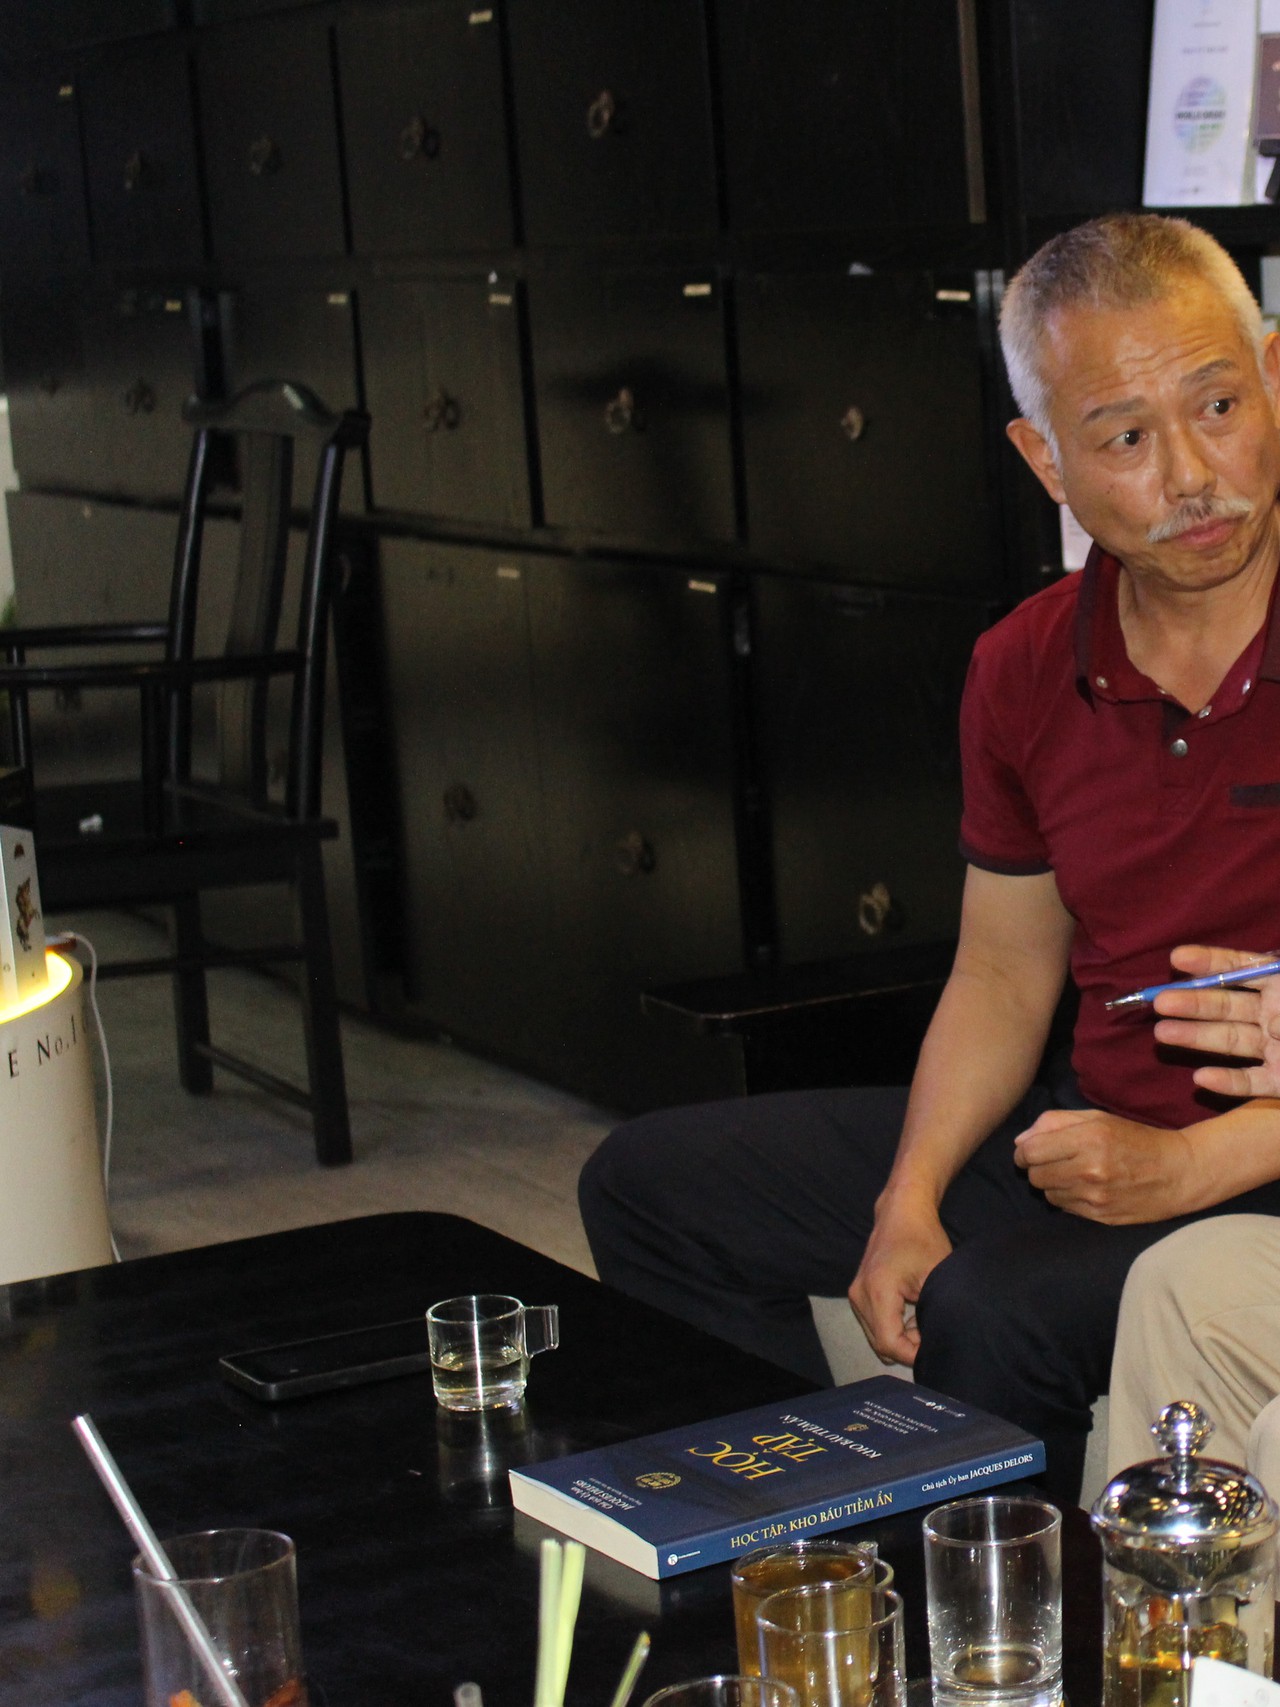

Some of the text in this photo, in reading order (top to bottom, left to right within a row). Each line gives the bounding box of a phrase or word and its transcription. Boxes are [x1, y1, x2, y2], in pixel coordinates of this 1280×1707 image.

[687, 1441, 786, 1480] HỌC
[752, 1432, 829, 1463] TẬP
[921, 1483, 935, 1492] Chủ
[958, 1474, 969, 1482] ban
[969, 1462, 1004, 1480] JACQUES
[1003, 1453, 1034, 1469] DELORS
[731, 1491, 894, 1549] HỌC TẬP: KHO BÁU TIỀM ẨN
